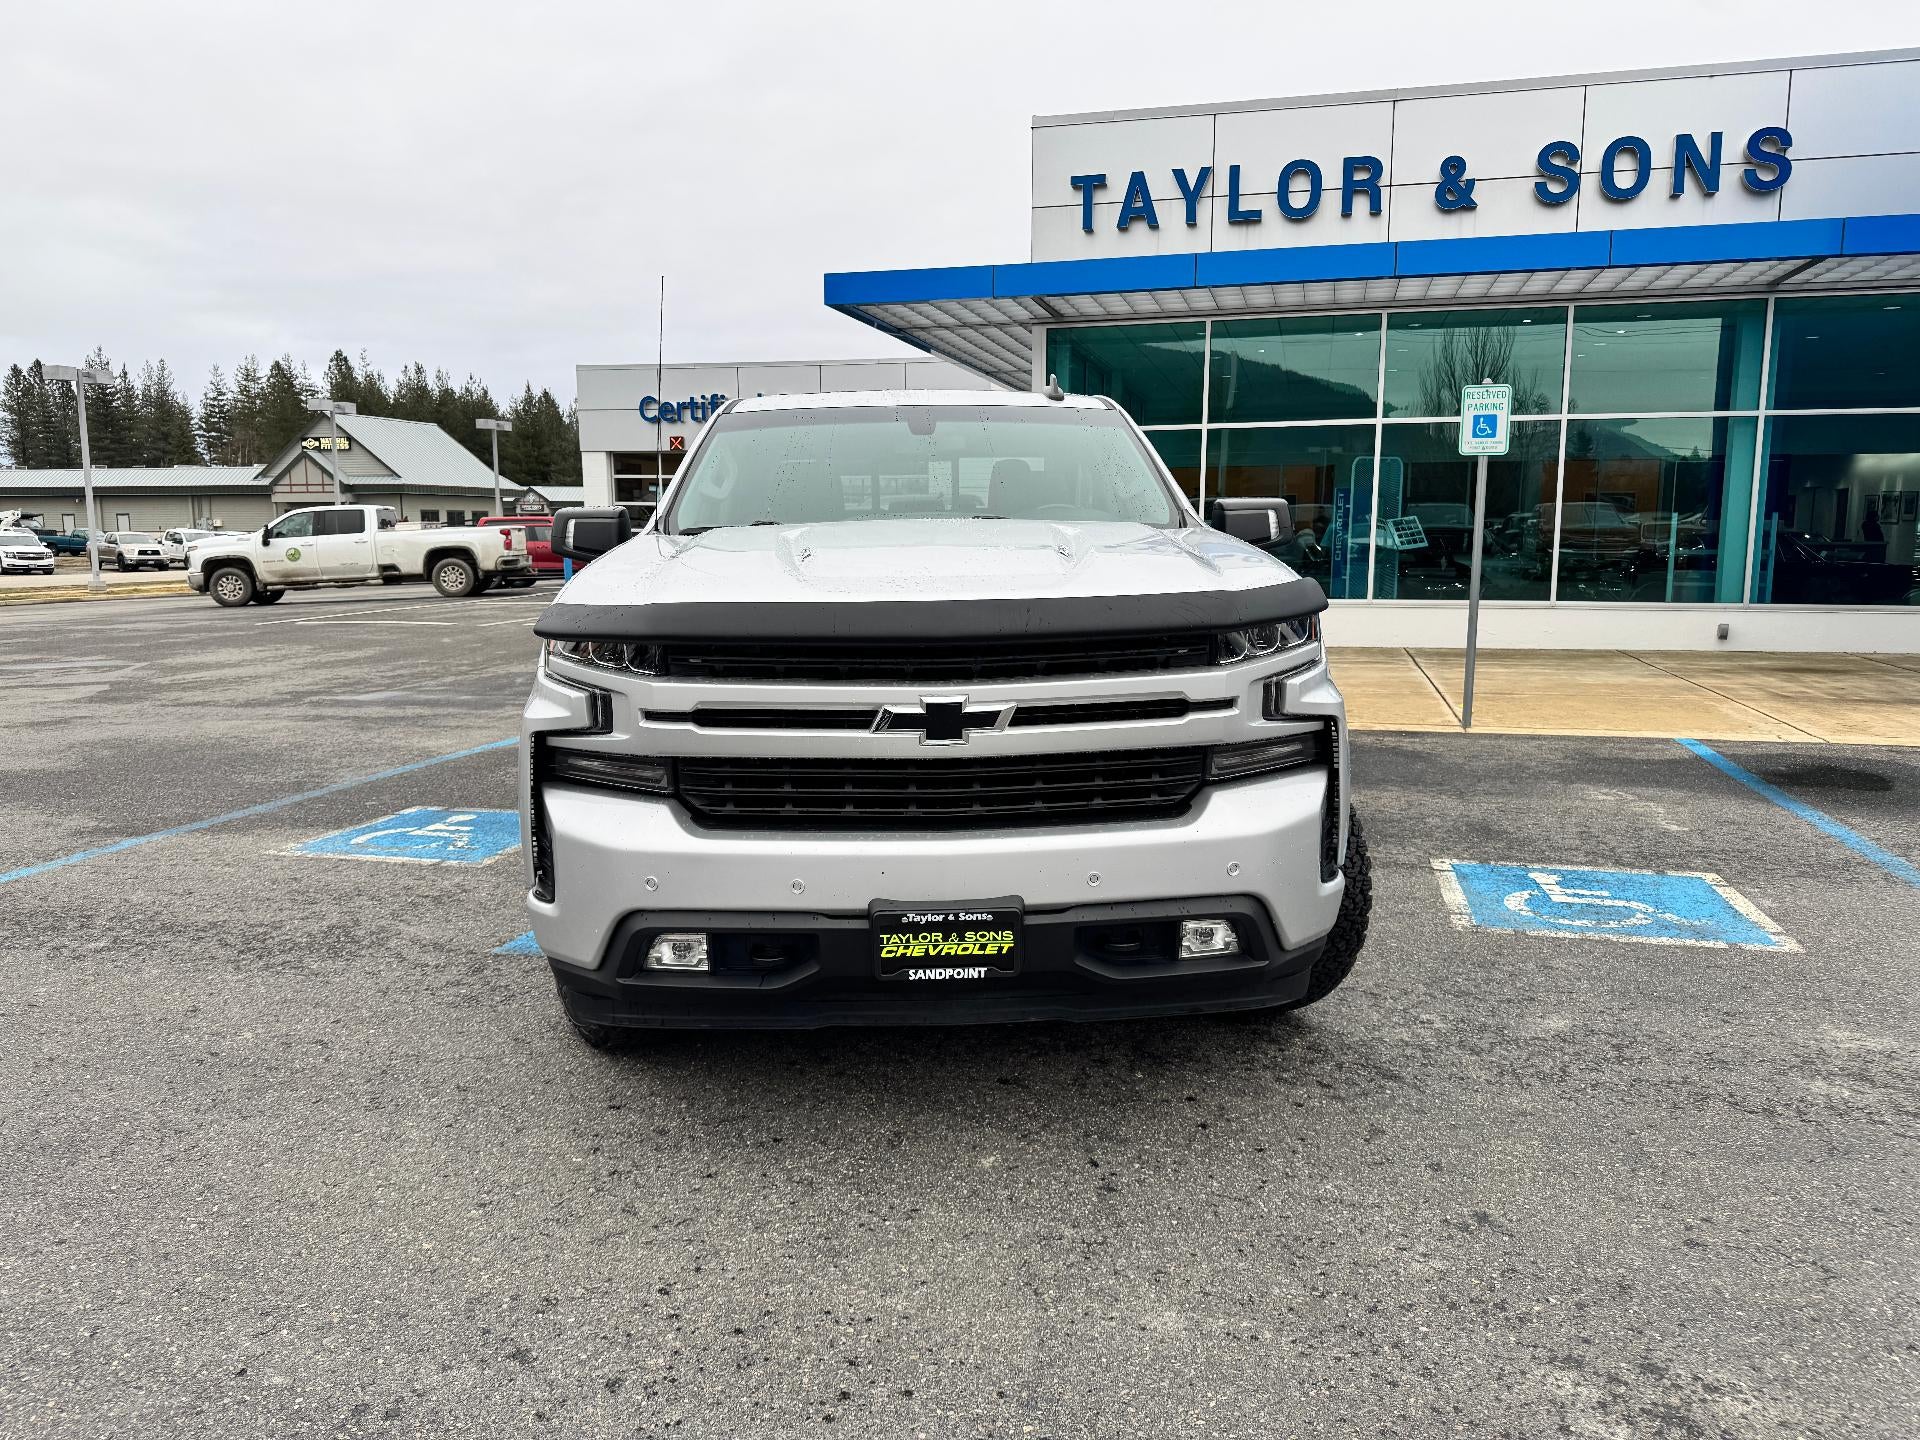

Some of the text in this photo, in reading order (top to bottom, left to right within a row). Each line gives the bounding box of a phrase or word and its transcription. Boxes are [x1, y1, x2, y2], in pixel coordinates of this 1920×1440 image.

[1071, 126, 1793, 232] TAYLOR & SONS
[1466, 391, 1507, 399] RESERVED
[639, 394, 727, 423] Certif
[1467, 402, 1504, 411] PARKING
[1335, 493, 1344, 561] CHEVROLET
[907, 912, 987, 924] Taylor & Sons
[879, 930, 1014, 944] TAYLOR & SONS
[880, 943, 1015, 958] CHEVROLET
[908, 967, 988, 980] SANDPOINT
